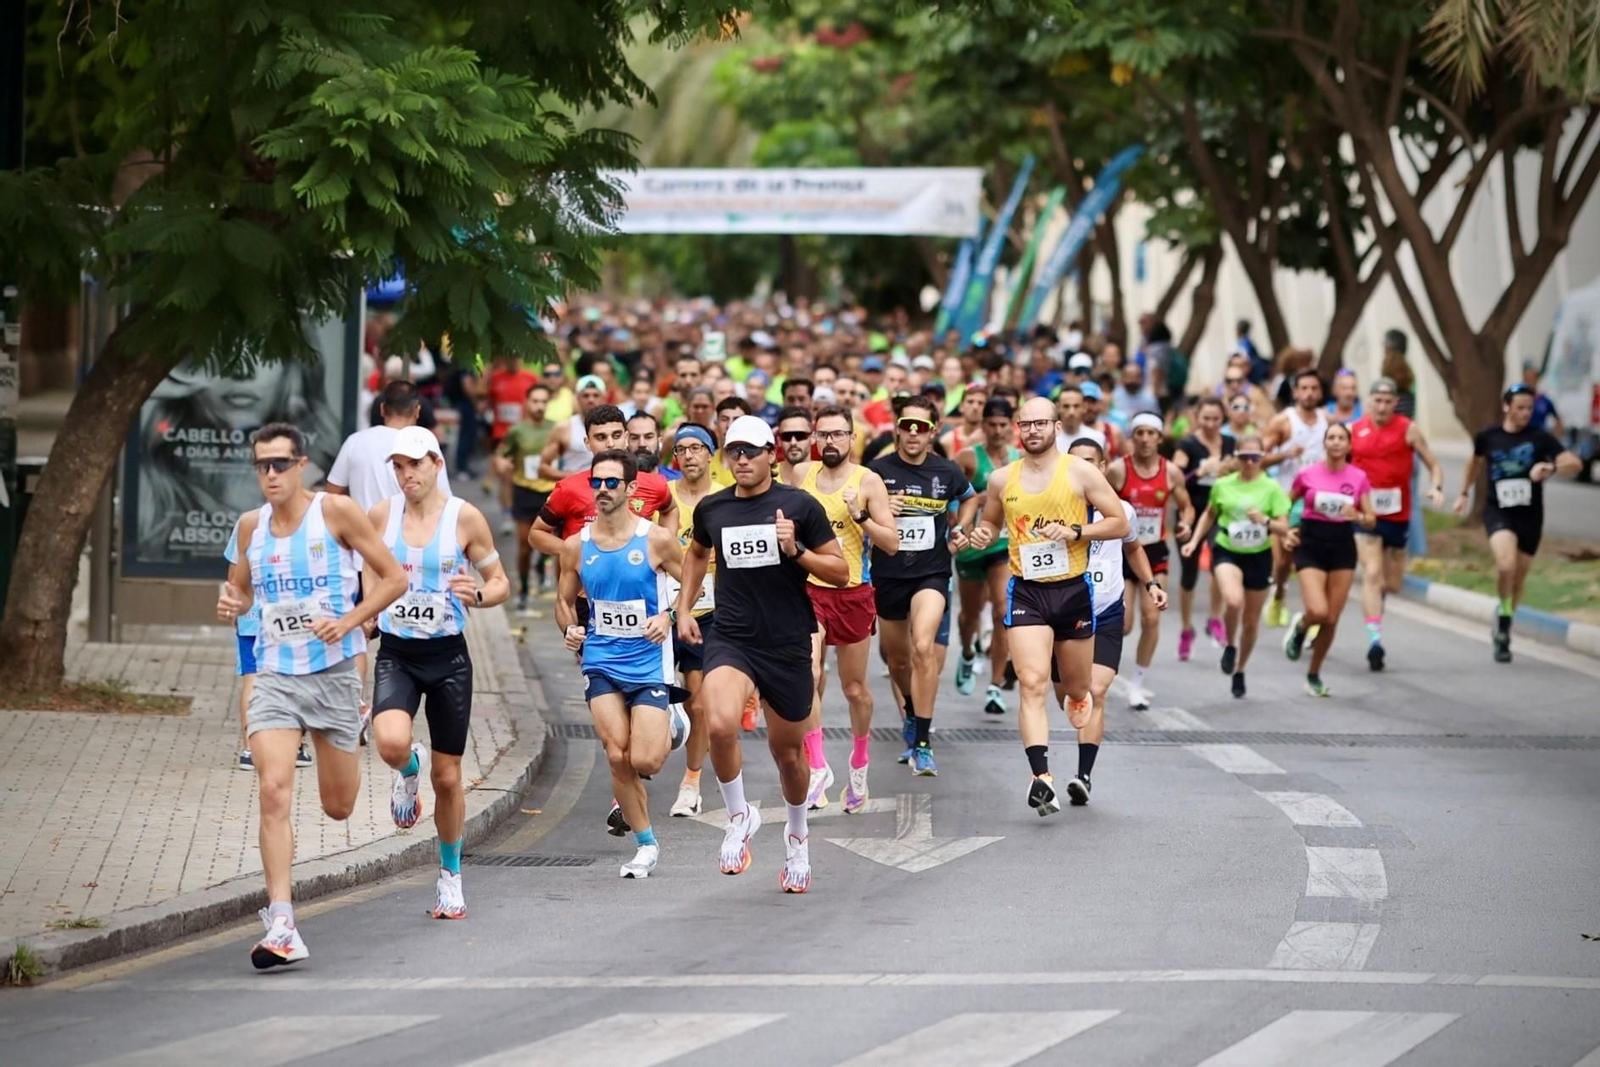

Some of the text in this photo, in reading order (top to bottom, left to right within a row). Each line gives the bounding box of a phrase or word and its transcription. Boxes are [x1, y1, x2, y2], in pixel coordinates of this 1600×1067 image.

[162, 427, 245, 444] CABELLO
[173, 449, 183, 458] 4
[186, 444, 221, 458] DÍAS
[186, 510, 237, 527] GLOS
[730, 540, 768, 556] 859
[1032, 553, 1054, 567] 33
[254, 574, 328, 595] málaga
[394, 605, 434, 620] 344
[602, 612, 638, 627] 510
[273, 613, 313, 632] 125
